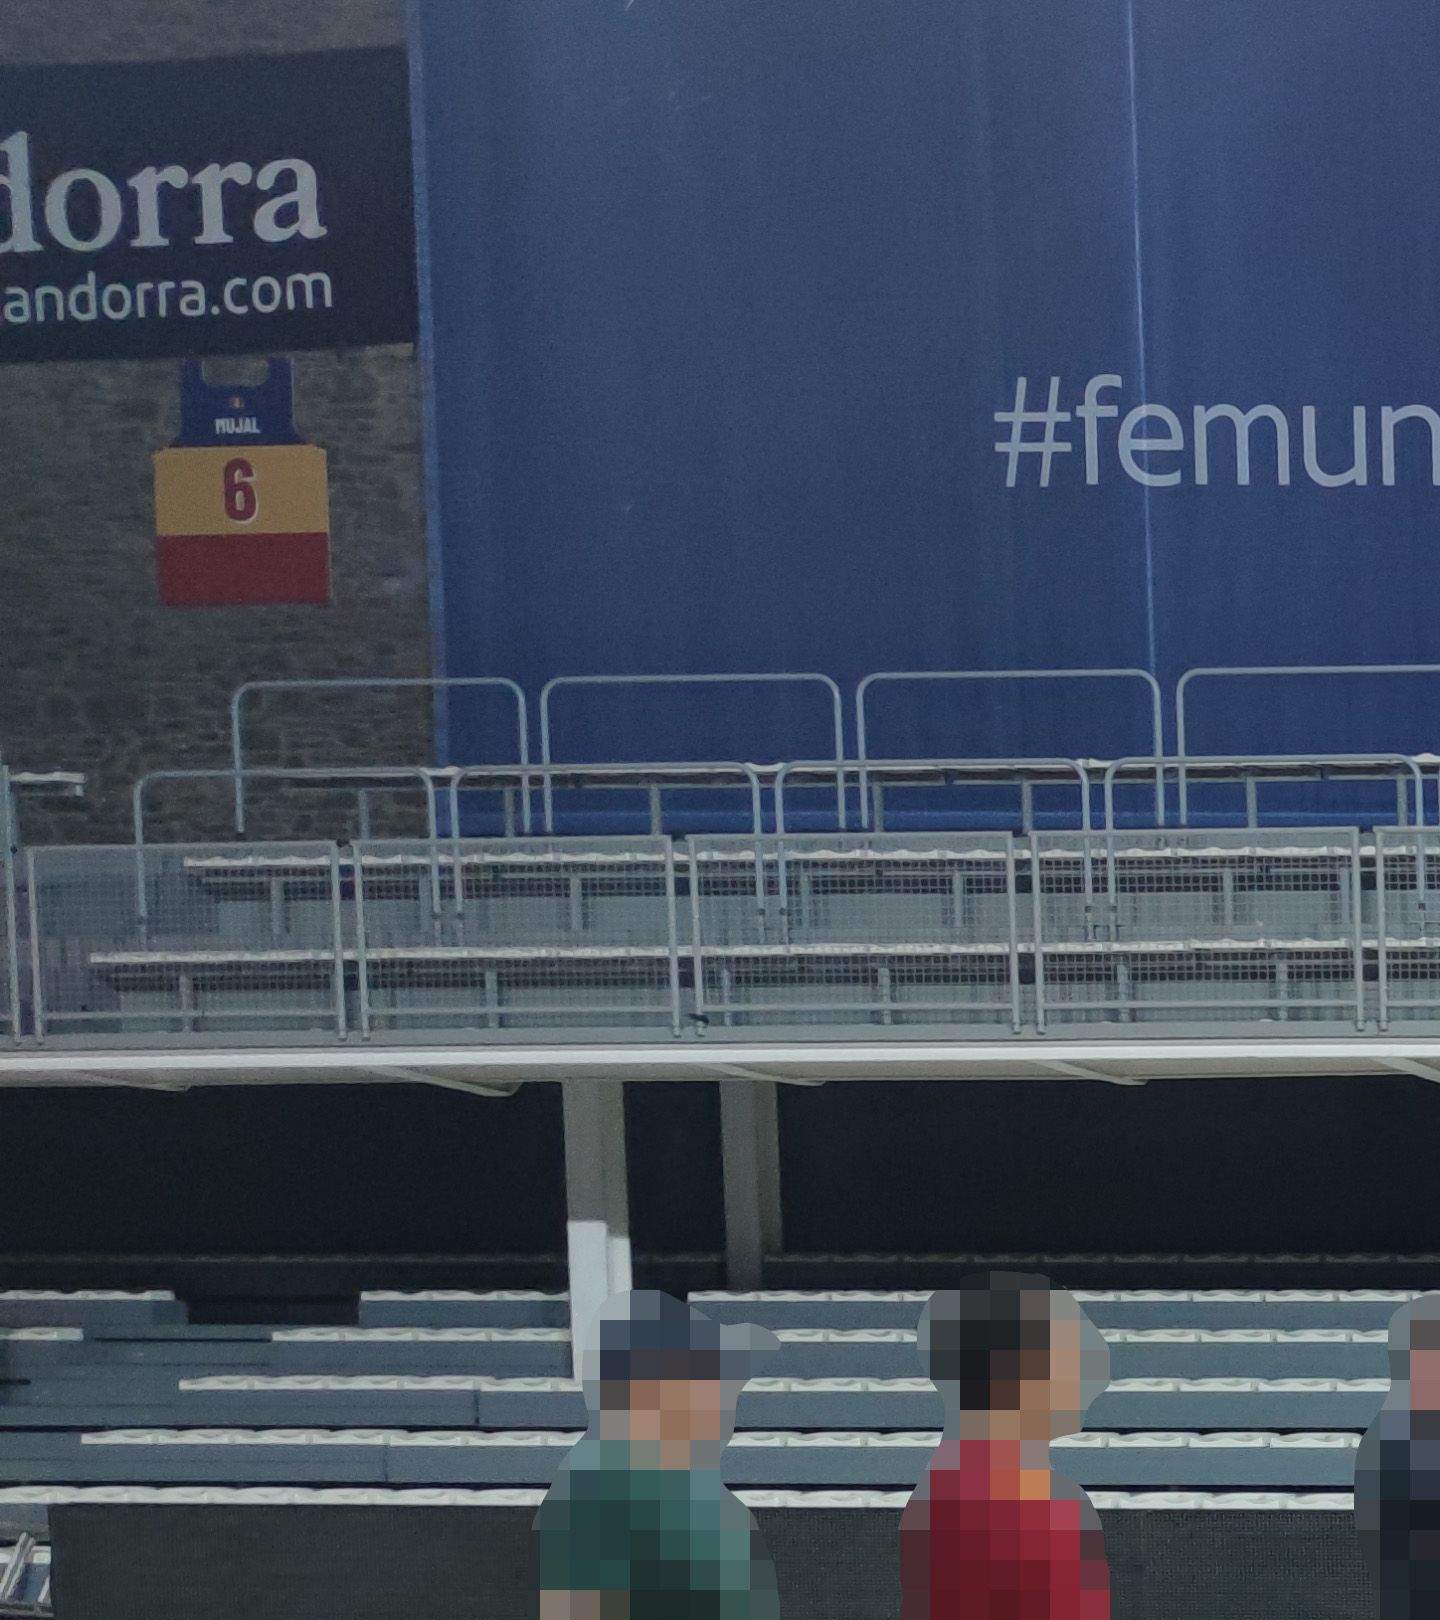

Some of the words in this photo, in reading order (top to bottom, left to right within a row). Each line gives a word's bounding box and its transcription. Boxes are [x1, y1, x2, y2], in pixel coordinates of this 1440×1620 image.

[4, 270, 333, 324] andorra.com
[215, 416, 261, 435] MUJAL
[223, 456, 259, 525] 6
